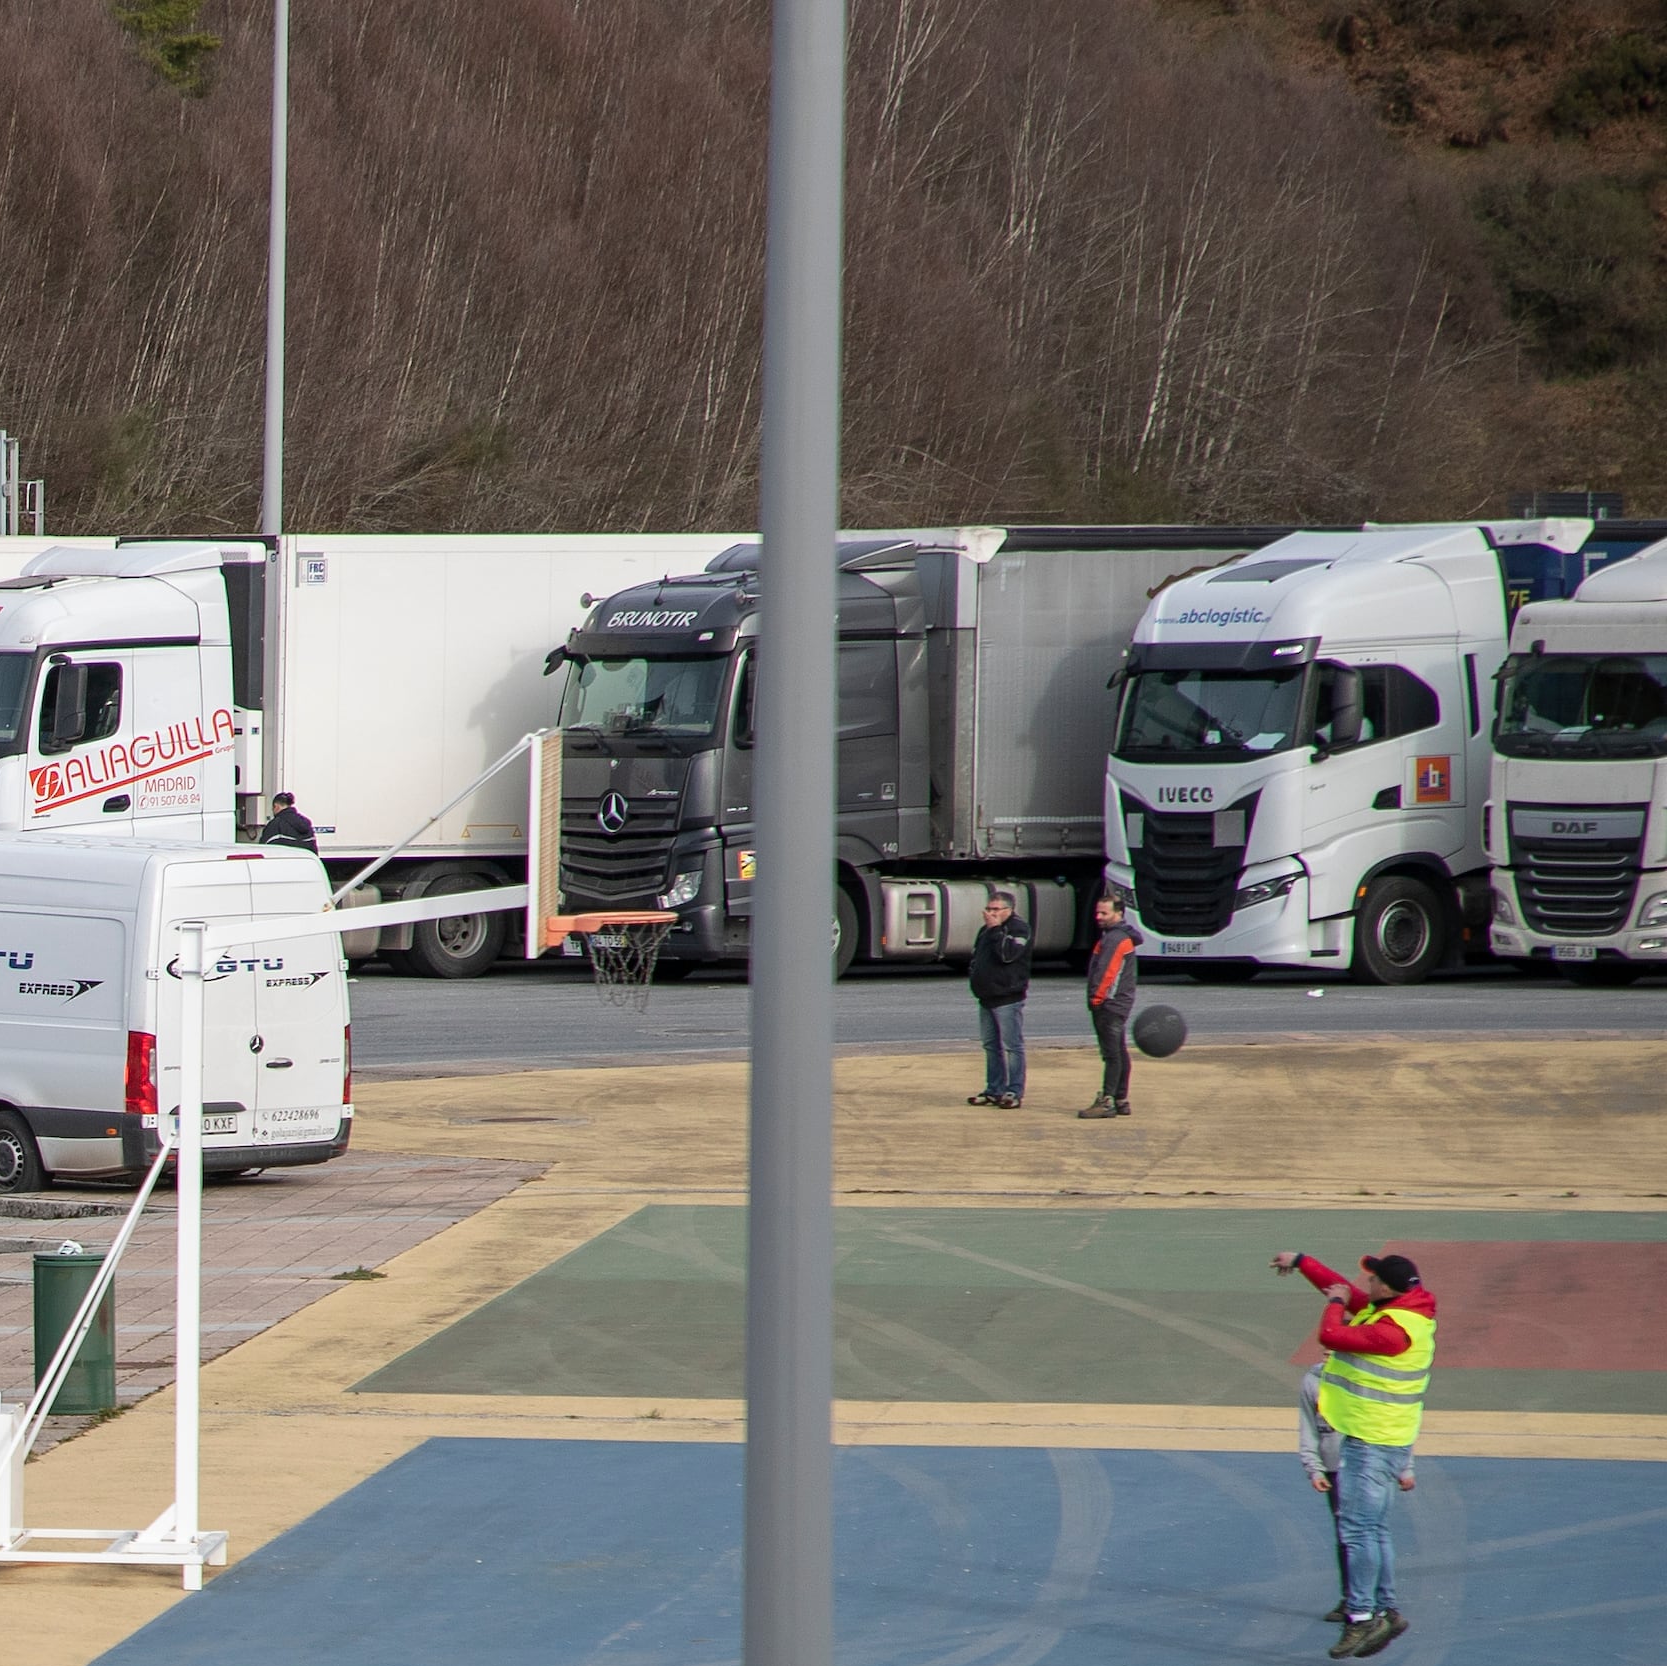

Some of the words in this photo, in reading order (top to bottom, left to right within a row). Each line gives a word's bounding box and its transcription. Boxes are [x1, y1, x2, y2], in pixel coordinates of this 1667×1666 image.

[607, 611, 698, 627] BRUNOTIR
[64, 708, 235, 793] ALIAGUILLA
[144, 776, 196, 793] MADRID
[149, 796, 159, 806] 91
[161, 795, 176, 806] 507
[1158, 787, 1214, 803] IVECO
[1551, 820, 1597, 834] DAF
[882, 841, 898, 853] 140
[216, 957, 284, 972] GTU
[18, 982, 74, 997] EXPRESS
[266, 977, 310, 988] EXPRESS
[271, 1109, 320, 1122] 622428696
[214, 1117, 234, 1130] KXF
